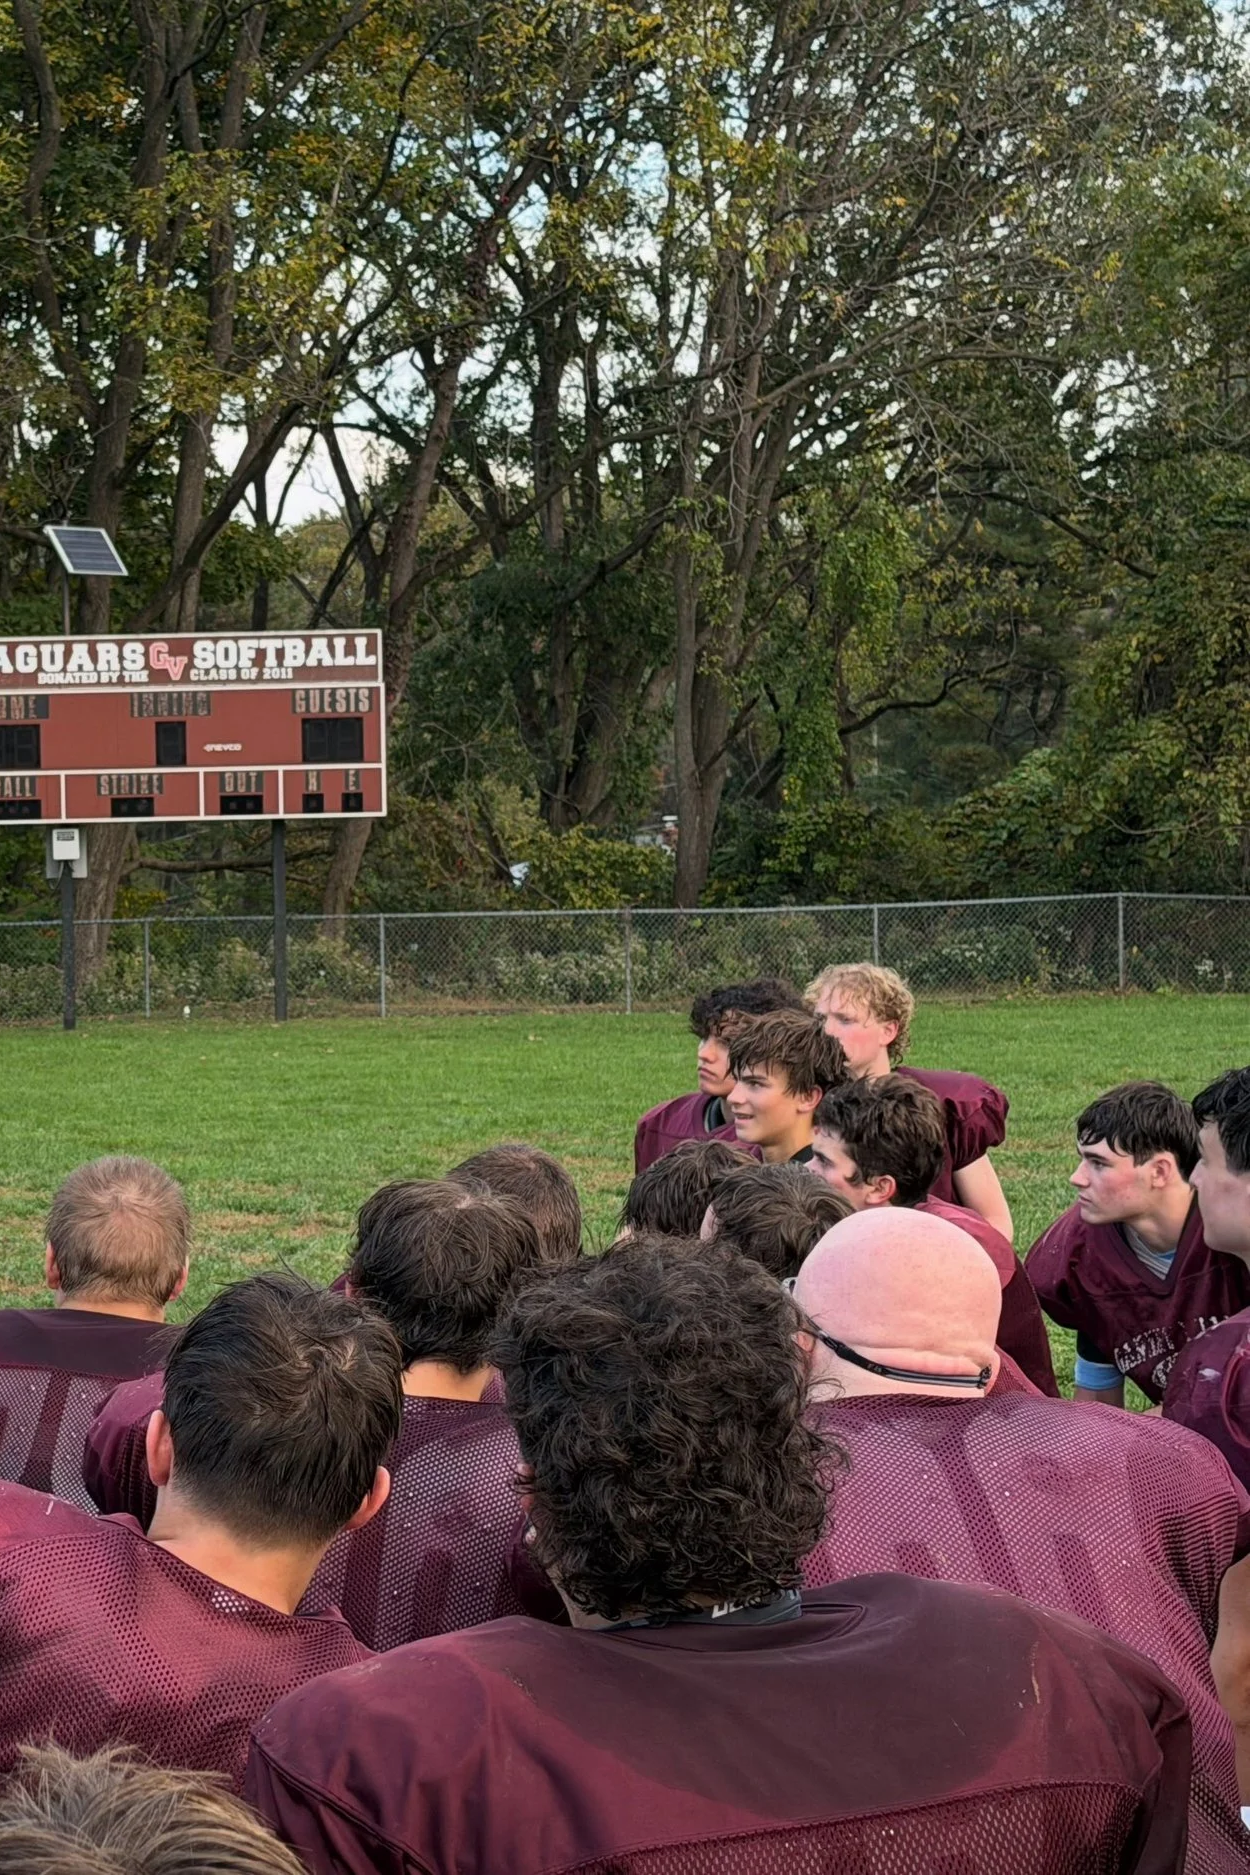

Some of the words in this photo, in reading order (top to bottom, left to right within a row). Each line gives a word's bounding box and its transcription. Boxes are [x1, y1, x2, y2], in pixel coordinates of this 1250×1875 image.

[149, 641, 189, 681] GV
[192, 636, 377, 669] SOFTBALL
[37, 671, 99, 685] DONATED
[99, 671, 121, 684] BY
[122, 669, 150, 683] THE
[189, 667, 238, 681] CLASS
[240, 667, 260, 680] OF
[262, 666, 294, 680] 2011
[294, 687, 370, 714] GUESTS
[99, 773, 161, 795] STRIKE
[224, 771, 258, 793] OUT
